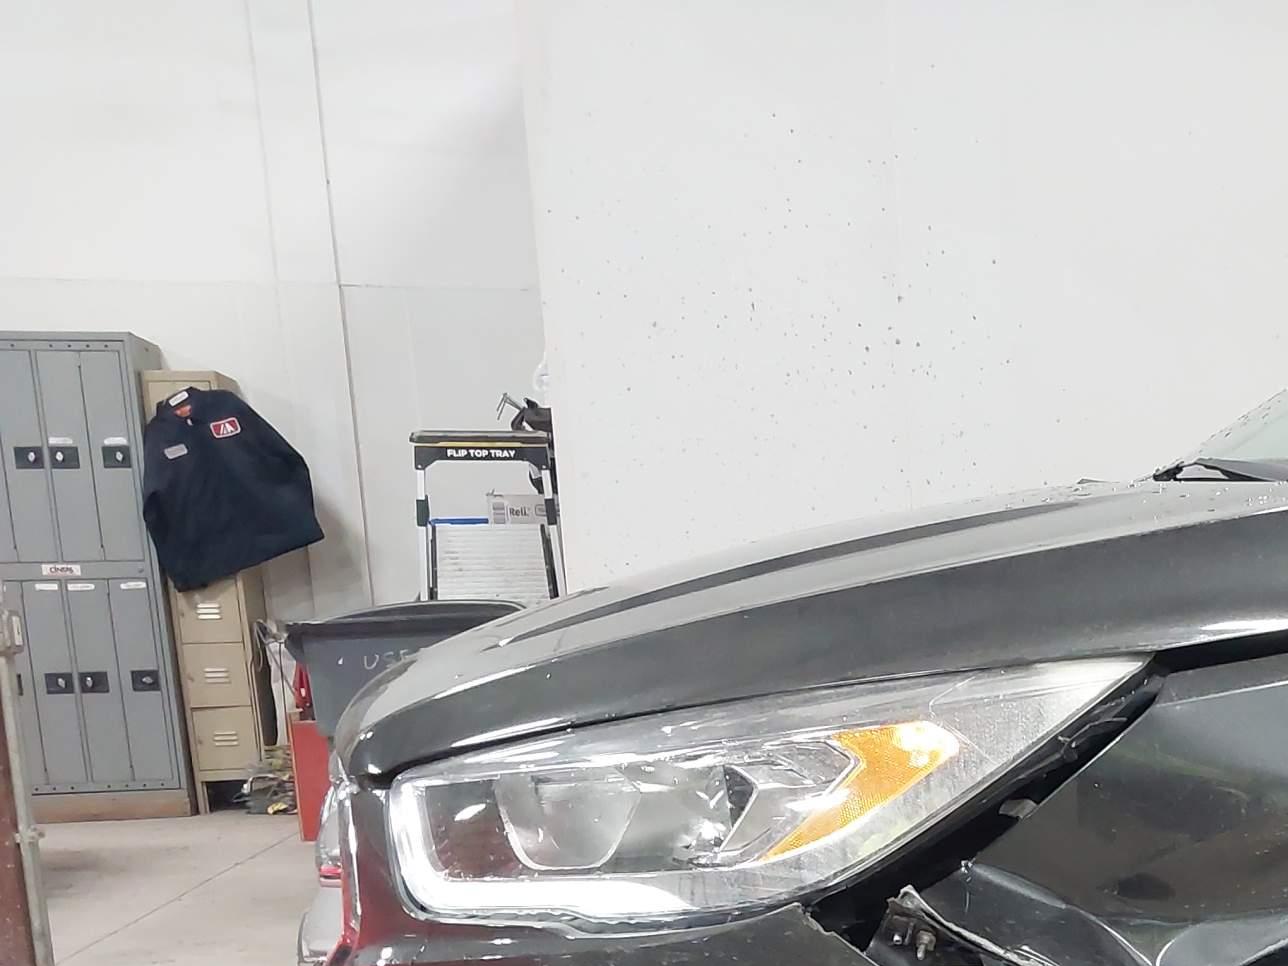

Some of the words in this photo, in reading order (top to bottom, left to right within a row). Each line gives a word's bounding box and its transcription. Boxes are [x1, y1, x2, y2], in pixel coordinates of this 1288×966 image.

[447, 449, 468, 459] FLIP
[468, 449, 489, 459] TOP
[490, 449, 516, 459] TRAY
